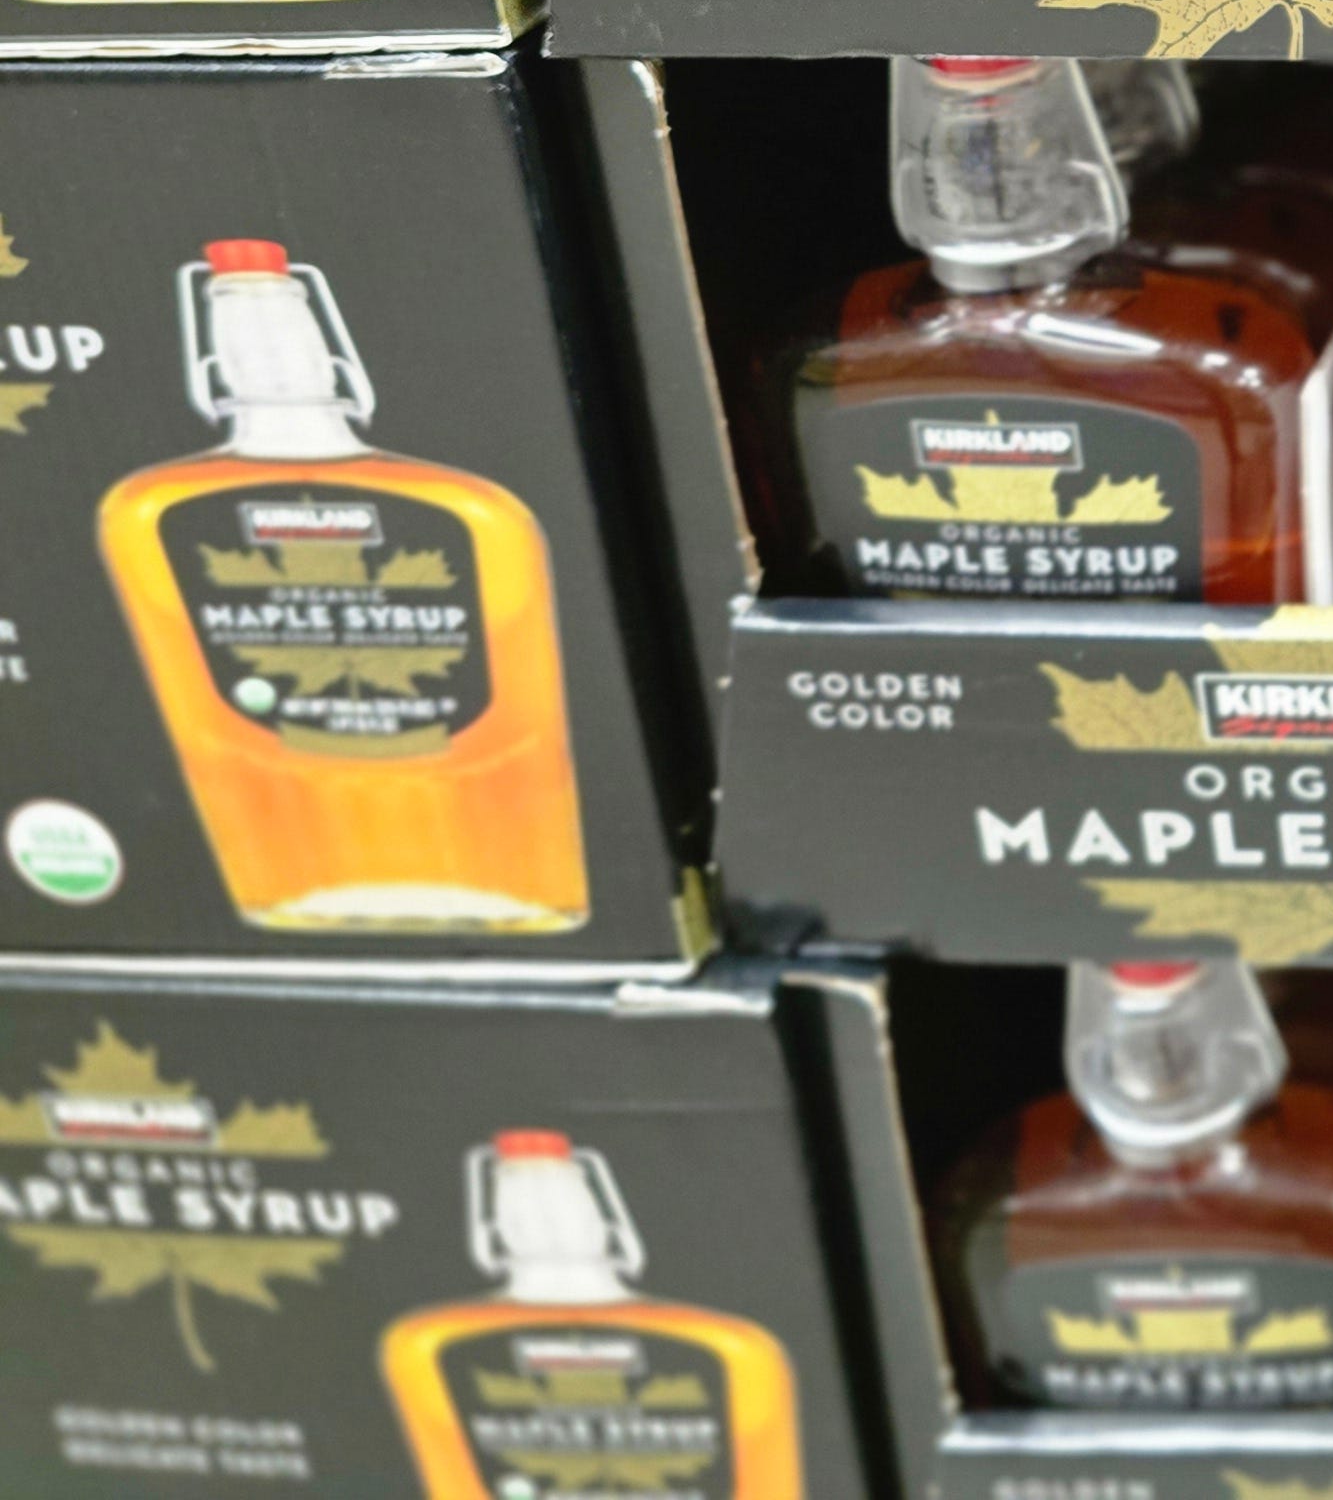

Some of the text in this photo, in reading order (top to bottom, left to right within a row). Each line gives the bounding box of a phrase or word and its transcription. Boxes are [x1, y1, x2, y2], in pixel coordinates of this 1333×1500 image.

[923, 427, 1072, 453] KIRKLAND
[941, 525, 1081, 543] ORGANIC
[856, 539, 1177, 575] MAPLE SYRUP
[788, 673, 962, 699] GOLDEN
[810, 702, 953, 729] COLOR
[976, 808, 1330, 866] MAPLE
